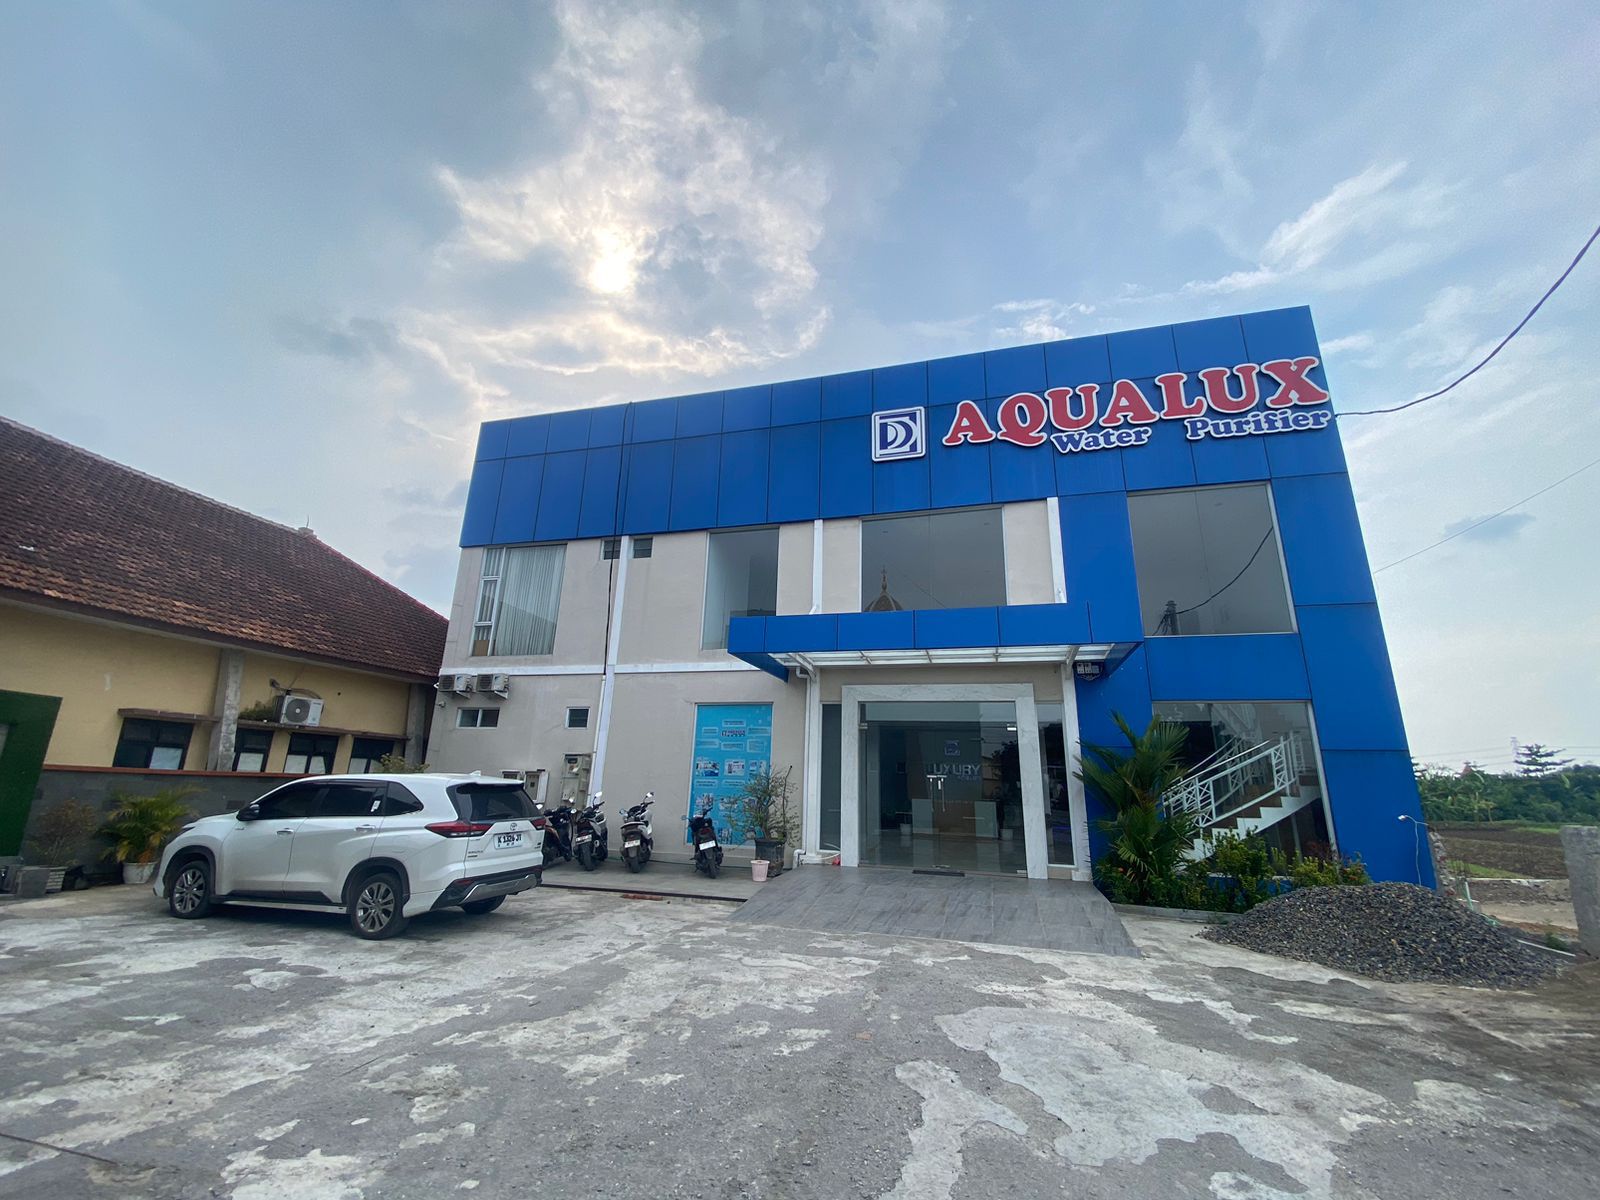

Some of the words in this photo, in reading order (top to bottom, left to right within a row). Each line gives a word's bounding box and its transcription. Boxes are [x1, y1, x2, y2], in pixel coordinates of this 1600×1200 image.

[942, 356, 1330, 447] AQUALUX
[1051, 427, 1152, 453] Water
[1184, 409, 1332, 440] Purifier
